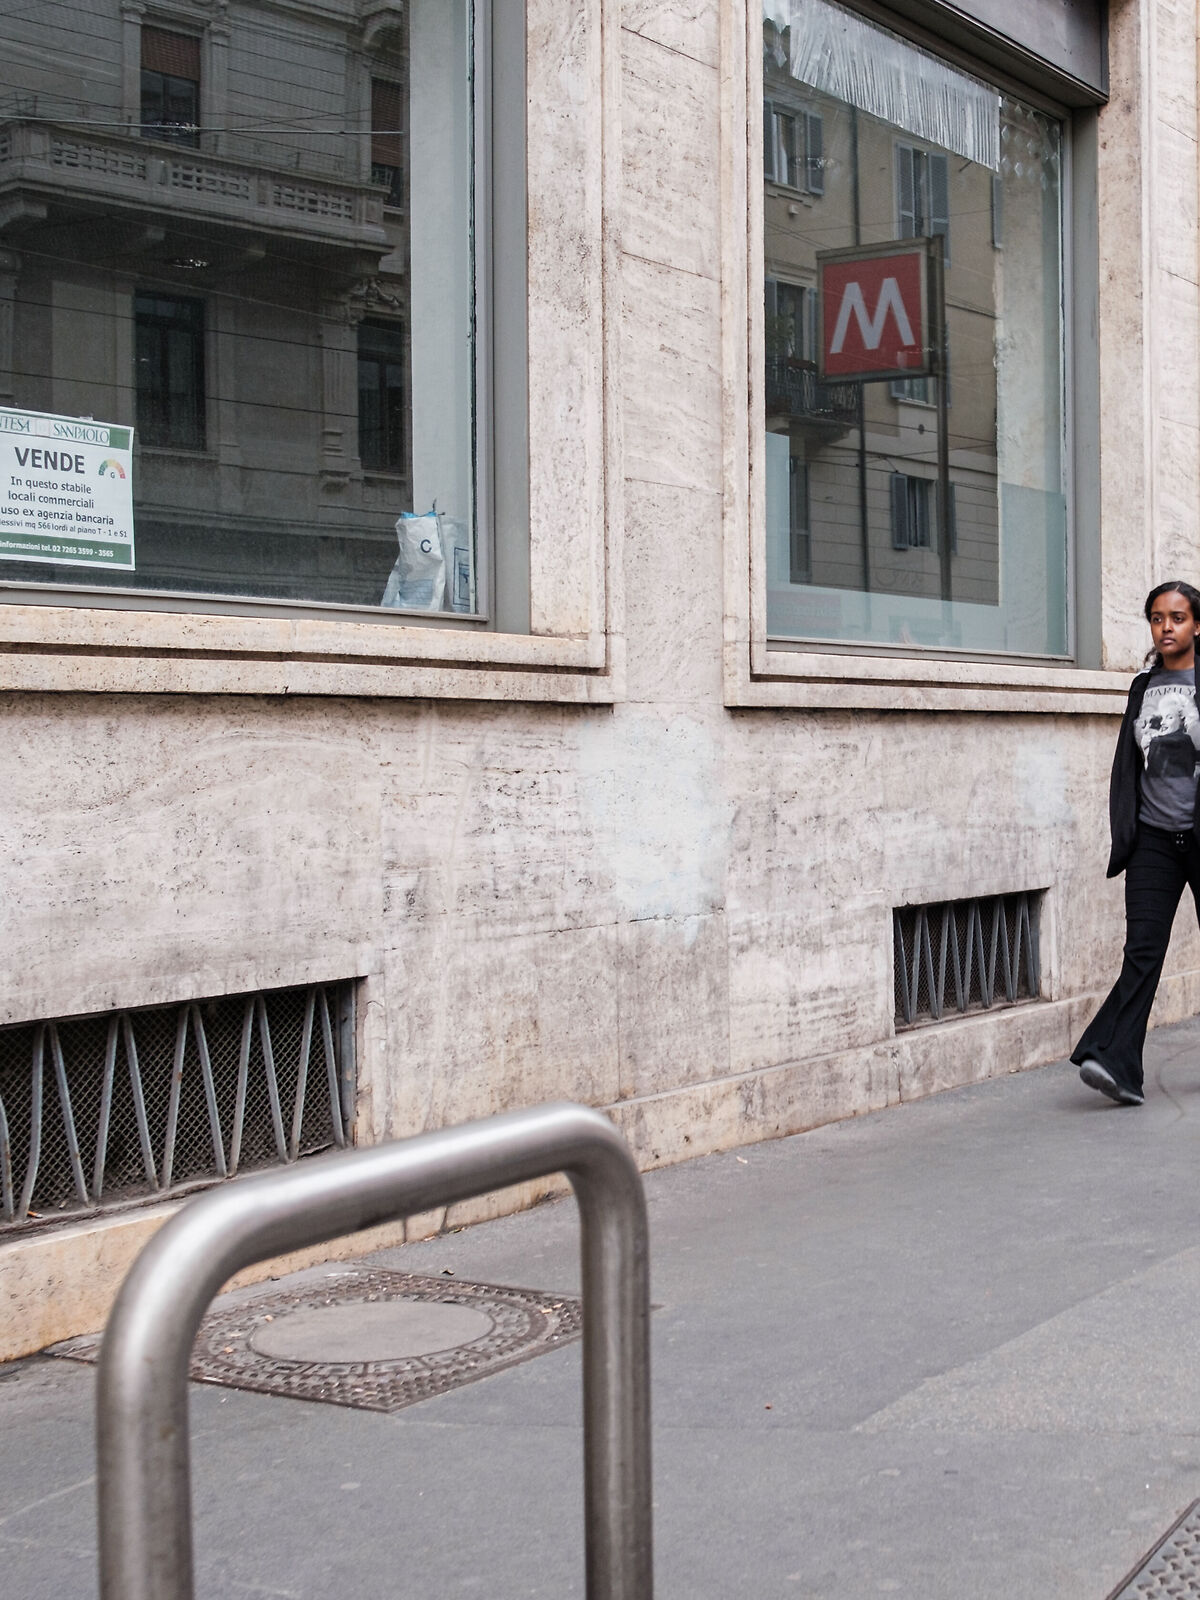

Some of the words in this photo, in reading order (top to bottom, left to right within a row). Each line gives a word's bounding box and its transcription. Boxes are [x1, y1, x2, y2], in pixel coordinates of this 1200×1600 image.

[54, 423, 109, 443] SANPAOLO
[14, 446, 85, 474] VENDE
[11, 475, 22, 486] In
[25, 479, 58, 490] questo
[61, 482, 91, 494] stabile
[8, 489, 36, 502] locali
[38, 494, 94, 508] commerciali
[1, 506, 19, 515] uso
[22, 508, 34, 517] ex
[37, 509, 72, 521] agenzia
[76, 511, 114, 525] bancaria
[25, 521, 36, 530] mq
[78, 526, 97, 535] piano
[120, 530, 128, 538] S1
[52, 544, 61, 553] 02
[420, 538, 432, 554] C
